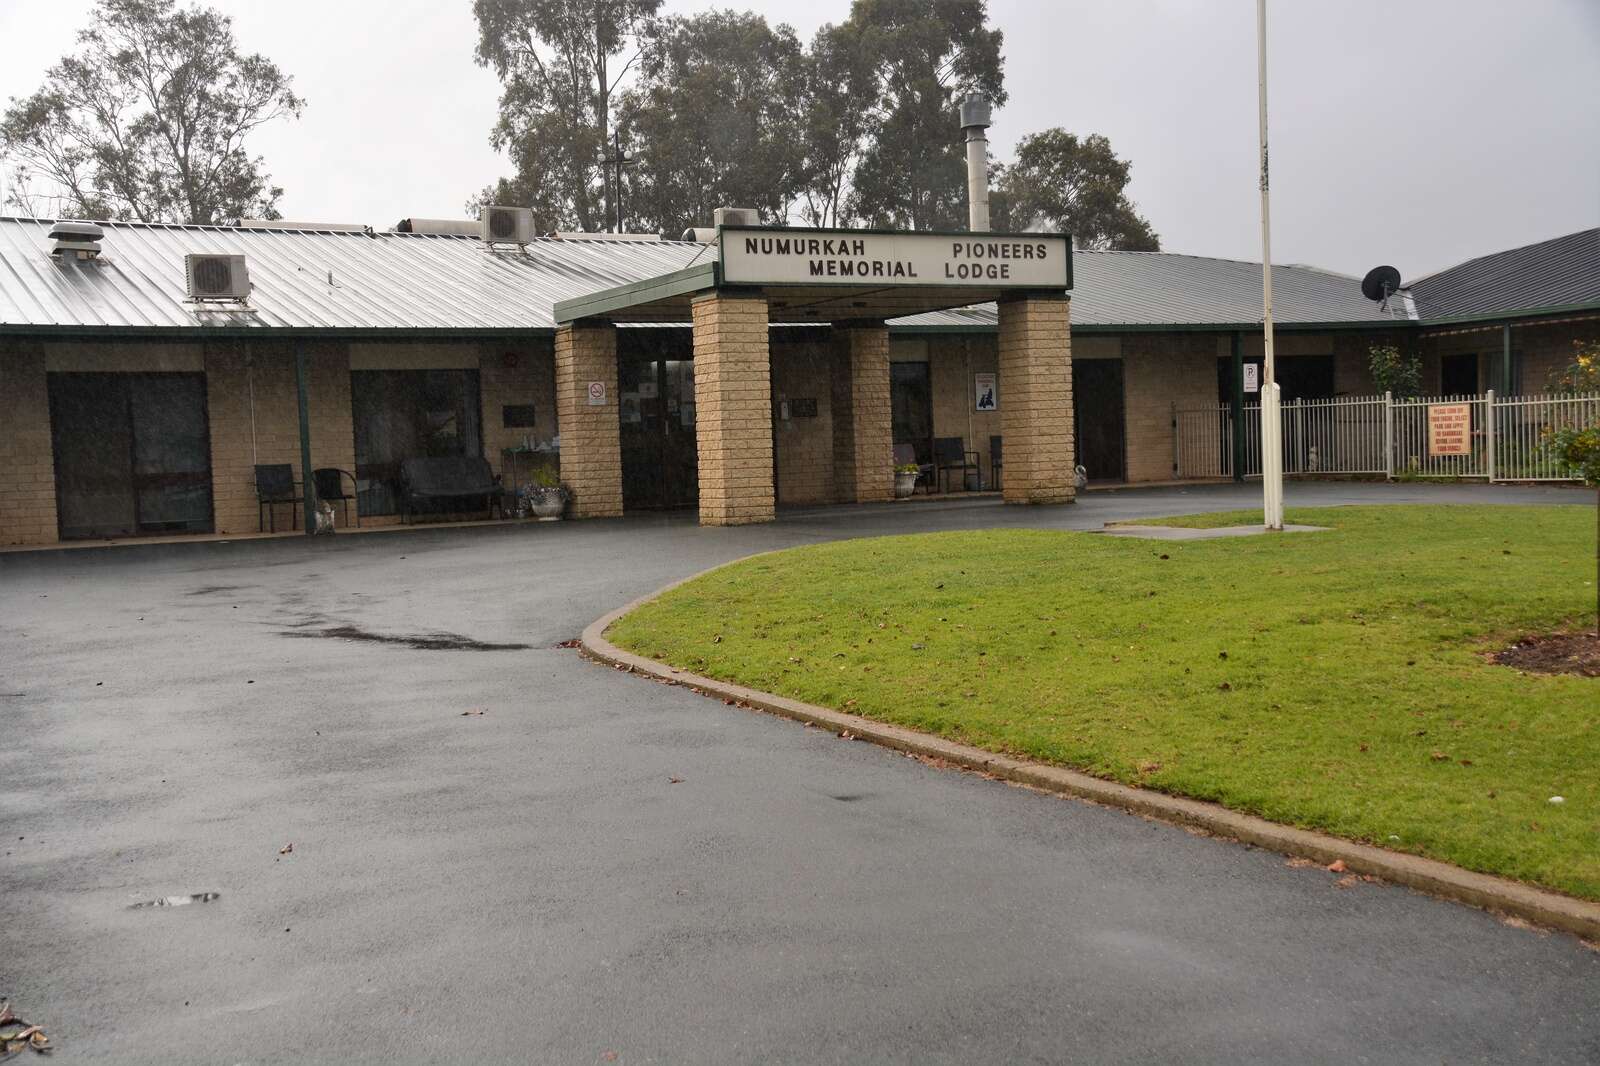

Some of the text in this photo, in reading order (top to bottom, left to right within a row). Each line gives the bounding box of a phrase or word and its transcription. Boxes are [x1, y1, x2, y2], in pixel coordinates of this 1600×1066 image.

[745, 238, 1048, 259] NUMURKAH PIONEERS
[809, 260, 1010, 280] MEMORIAL LODGE
